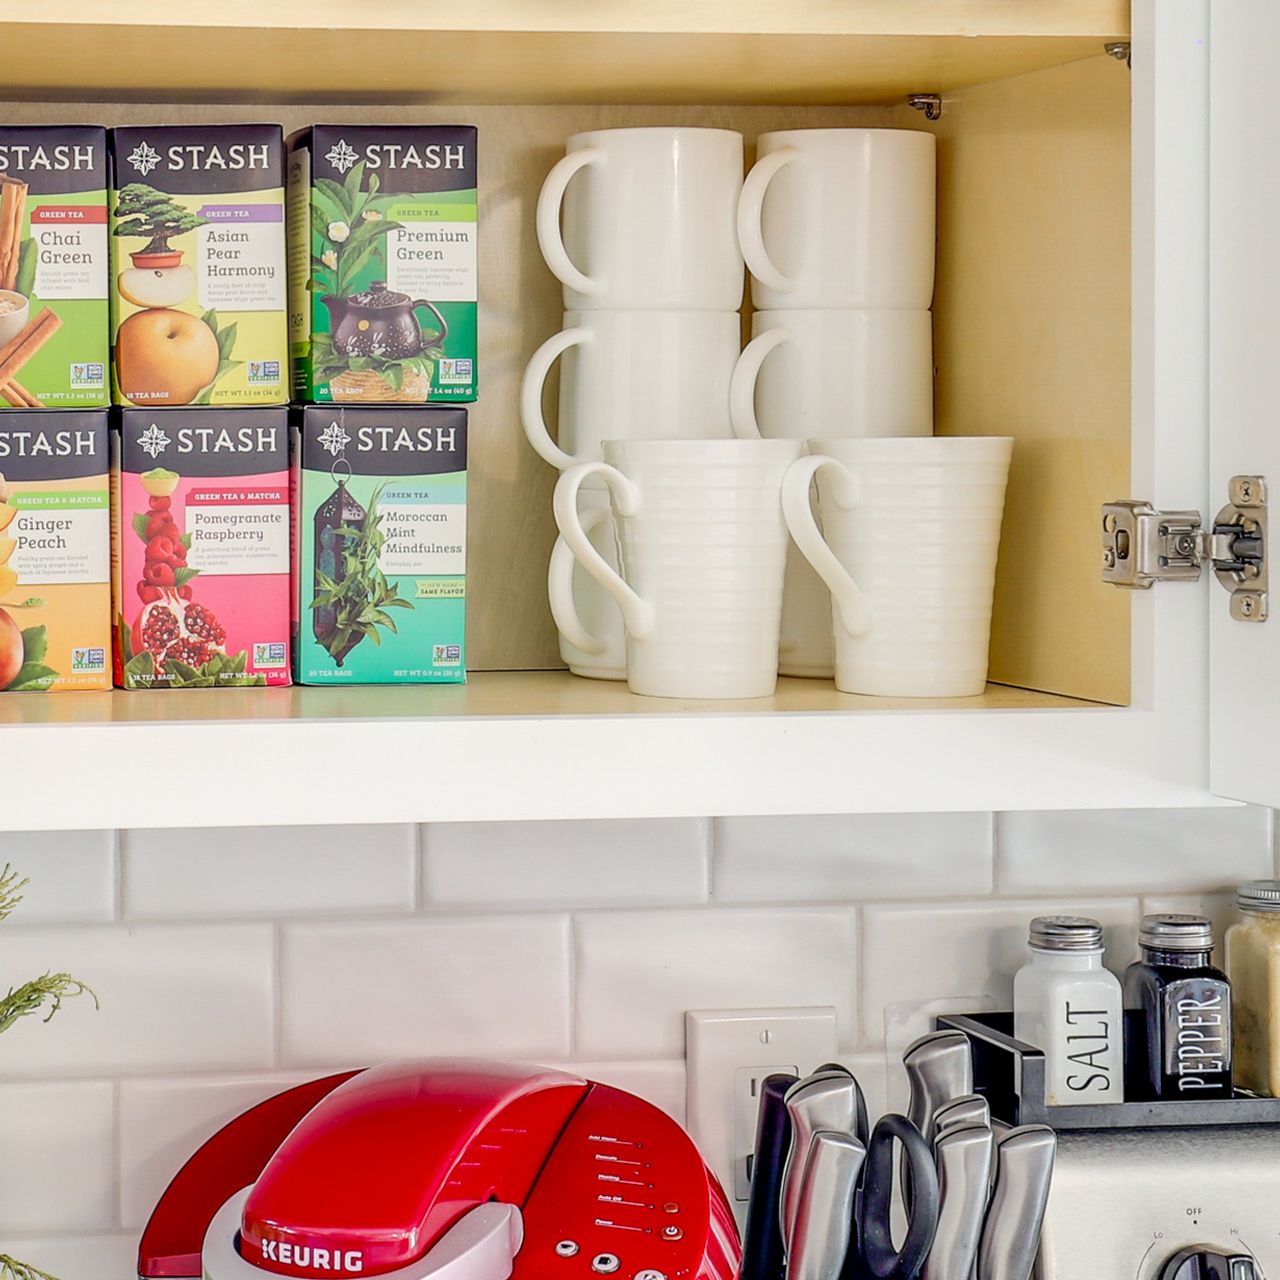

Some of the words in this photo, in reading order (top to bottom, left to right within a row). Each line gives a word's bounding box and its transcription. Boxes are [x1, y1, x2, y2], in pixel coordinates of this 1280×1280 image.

[168, 144, 269, 170] STASH
[366, 145, 465, 169] STASH
[40, 231, 81, 245] Chai
[207, 230, 249, 242] Asian
[397, 229, 468, 242] Premium
[41, 250, 92, 264] Green
[207, 248, 240, 259] Pear
[397, 248, 443, 260] Green
[208, 265, 274, 278] Harmony
[177, 428, 276, 452] STASH
[358, 427, 456, 451] STASH
[69, 496, 102, 504] MATCHA
[195, 514, 281, 526] Pomegranate
[386, 512, 447, 521] Moroccan
[18, 517, 72, 533] Ginger
[196, 529, 263, 542] Raspberry
[386, 527, 415, 537] Mint
[18, 535, 66, 549] Peach
[386, 543, 462, 553] Mindfulness
[1066, 1001, 1110, 1092] SALT
[1178, 994, 1222, 1092] PEPPER
[1186, 1207, 1202, 1216] OFF
[1153, 1231, 1164, 1239] Lo
[262, 1238, 362, 1272] KEURIG
